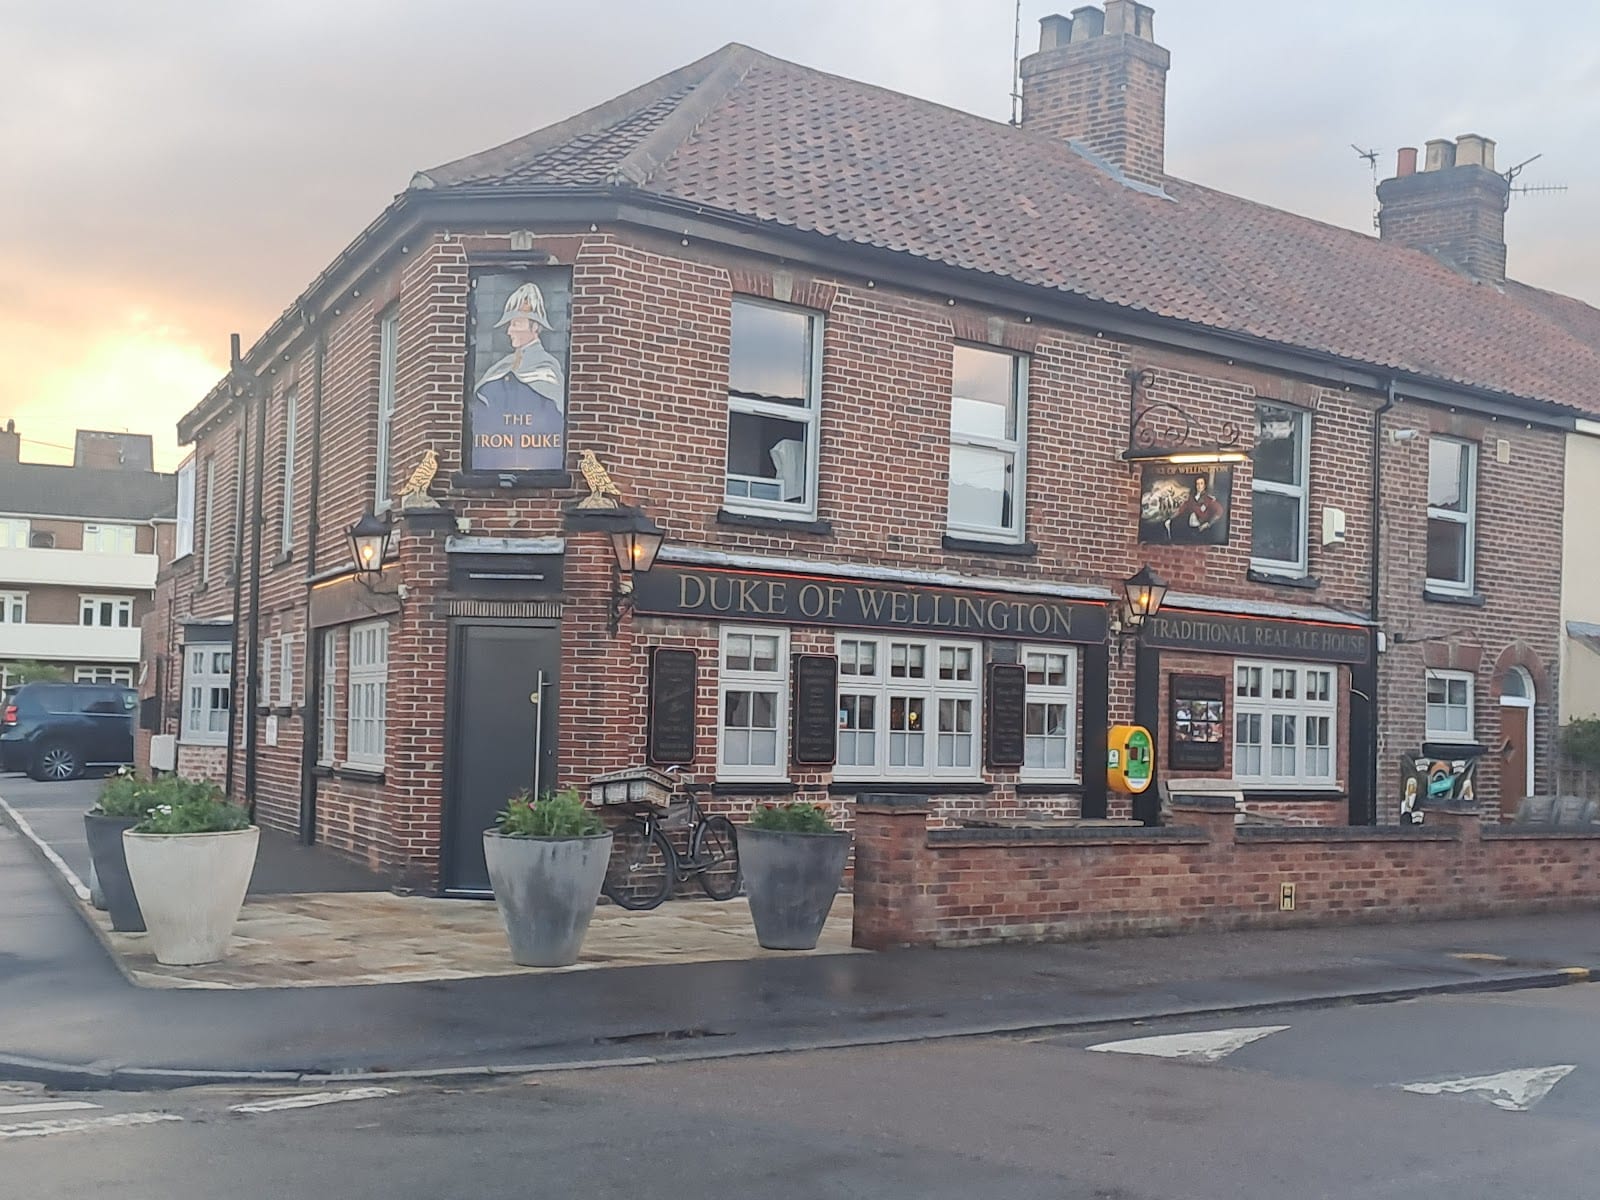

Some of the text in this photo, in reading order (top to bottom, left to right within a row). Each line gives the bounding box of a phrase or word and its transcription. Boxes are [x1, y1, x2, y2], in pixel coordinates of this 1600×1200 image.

[503, 414, 533, 426] THE
[474, 433, 561, 448] IRON DUKE
[677, 574, 1074, 635] DUKE OF WELLINGTON
[1150, 618, 1366, 652] TRADITIONAL REAL ALE HOUSE
